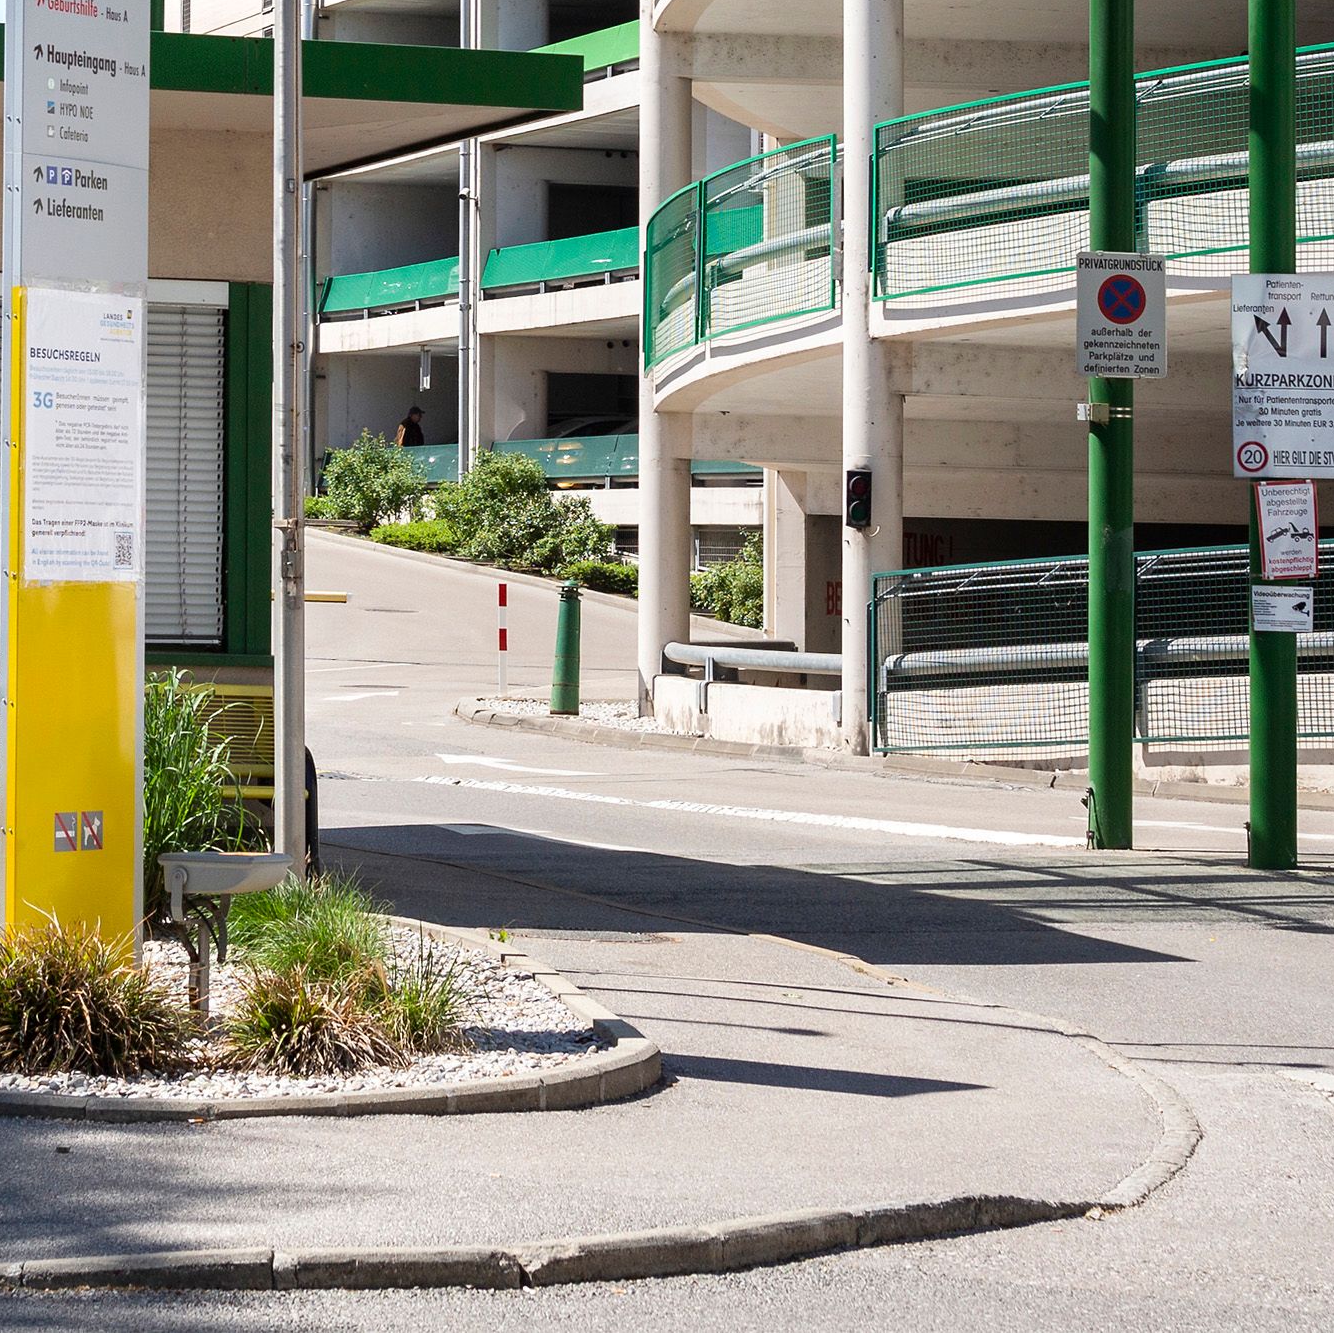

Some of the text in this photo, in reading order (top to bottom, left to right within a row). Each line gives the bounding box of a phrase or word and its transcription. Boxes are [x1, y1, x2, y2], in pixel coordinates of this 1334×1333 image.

[106, 7, 121, 22] Haus
[123, 9, 129, 23] A
[47, 44, 117, 78] Haupteingang
[124, 62, 139, 76] Haus
[141, 65, 146, 77] A
[60, 78, 89, 96] Infopoint
[60, 103, 94, 120] HYPO NOE
[59, 126, 89, 143] Cafeteria
[75, 168, 108, 191] Parken
[47, 197, 104, 222] Lieferanten
[1078, 257, 1163, 272] PRIVATGRUNDSTÜCK
[1266, 280, 1304, 290] Patienten-
[1268, 292, 1302, 302] transport
[1233, 304, 1274, 315] Lieferanten
[1090, 327, 1153, 338] außerhalb der
[1083, 340, 1160, 350] gekennzeichneten
[30, 347, 101, 363] BESUCHSREGELN
[1089, 351, 1155, 363] Parkplätze und
[1083, 364, 1160, 375] definierten Zonen
[33, 391, 53, 409] 3G
[1238, 396, 1252, 405] Nur
[1254, 395, 1264, 405] für
[1258, 407, 1322, 418] 30 Minuten gratis
[1236, 419, 1245, 428] Je
[1246, 419, 1272, 427] weitere
[1273, 419, 1283, 427] 30
[1285, 420, 1312, 428] Minuten
[1313, 420, 1327, 428] EUR
[1244, 450, 1263, 464] 20
[1273, 450, 1291, 465] HIER
[1292, 451, 1307, 465] GILT
[1309, 451, 1322, 465] DIE
[1261, 487, 1310, 497] Unberechtigt
[1267, 498, 1307, 508] abgestellte
[1267, 508, 1308, 517] Fahrzeuge
[1268, 556, 1314, 565] kostenpflichtig
[1271, 565, 1312, 573] abgeschleppt
[1254, 590, 1310, 599] Videoüberwachung
